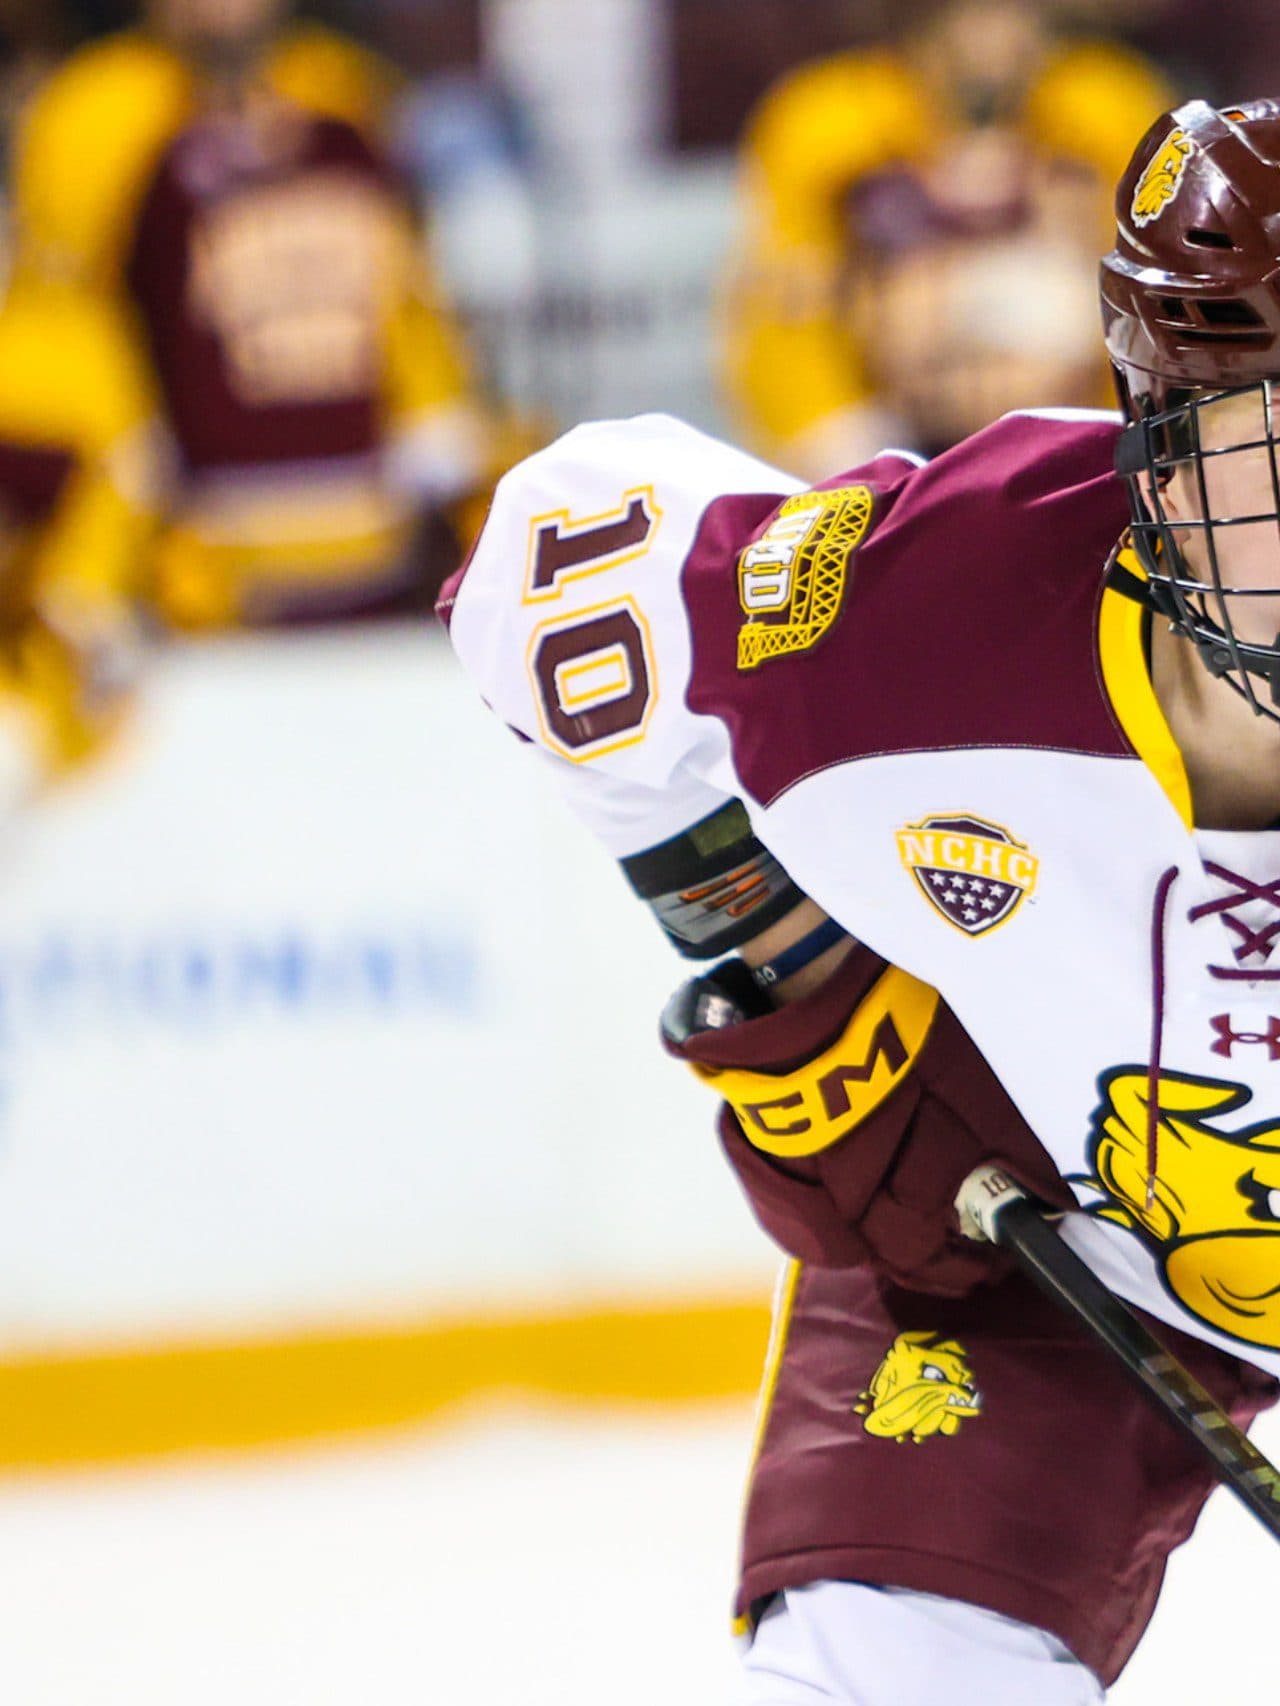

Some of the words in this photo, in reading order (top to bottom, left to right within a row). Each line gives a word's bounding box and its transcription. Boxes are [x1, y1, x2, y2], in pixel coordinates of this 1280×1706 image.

[522, 484, 663, 765] 10
[899, 832, 1035, 888] NCHC
[736, 1012, 909, 1135] CM
